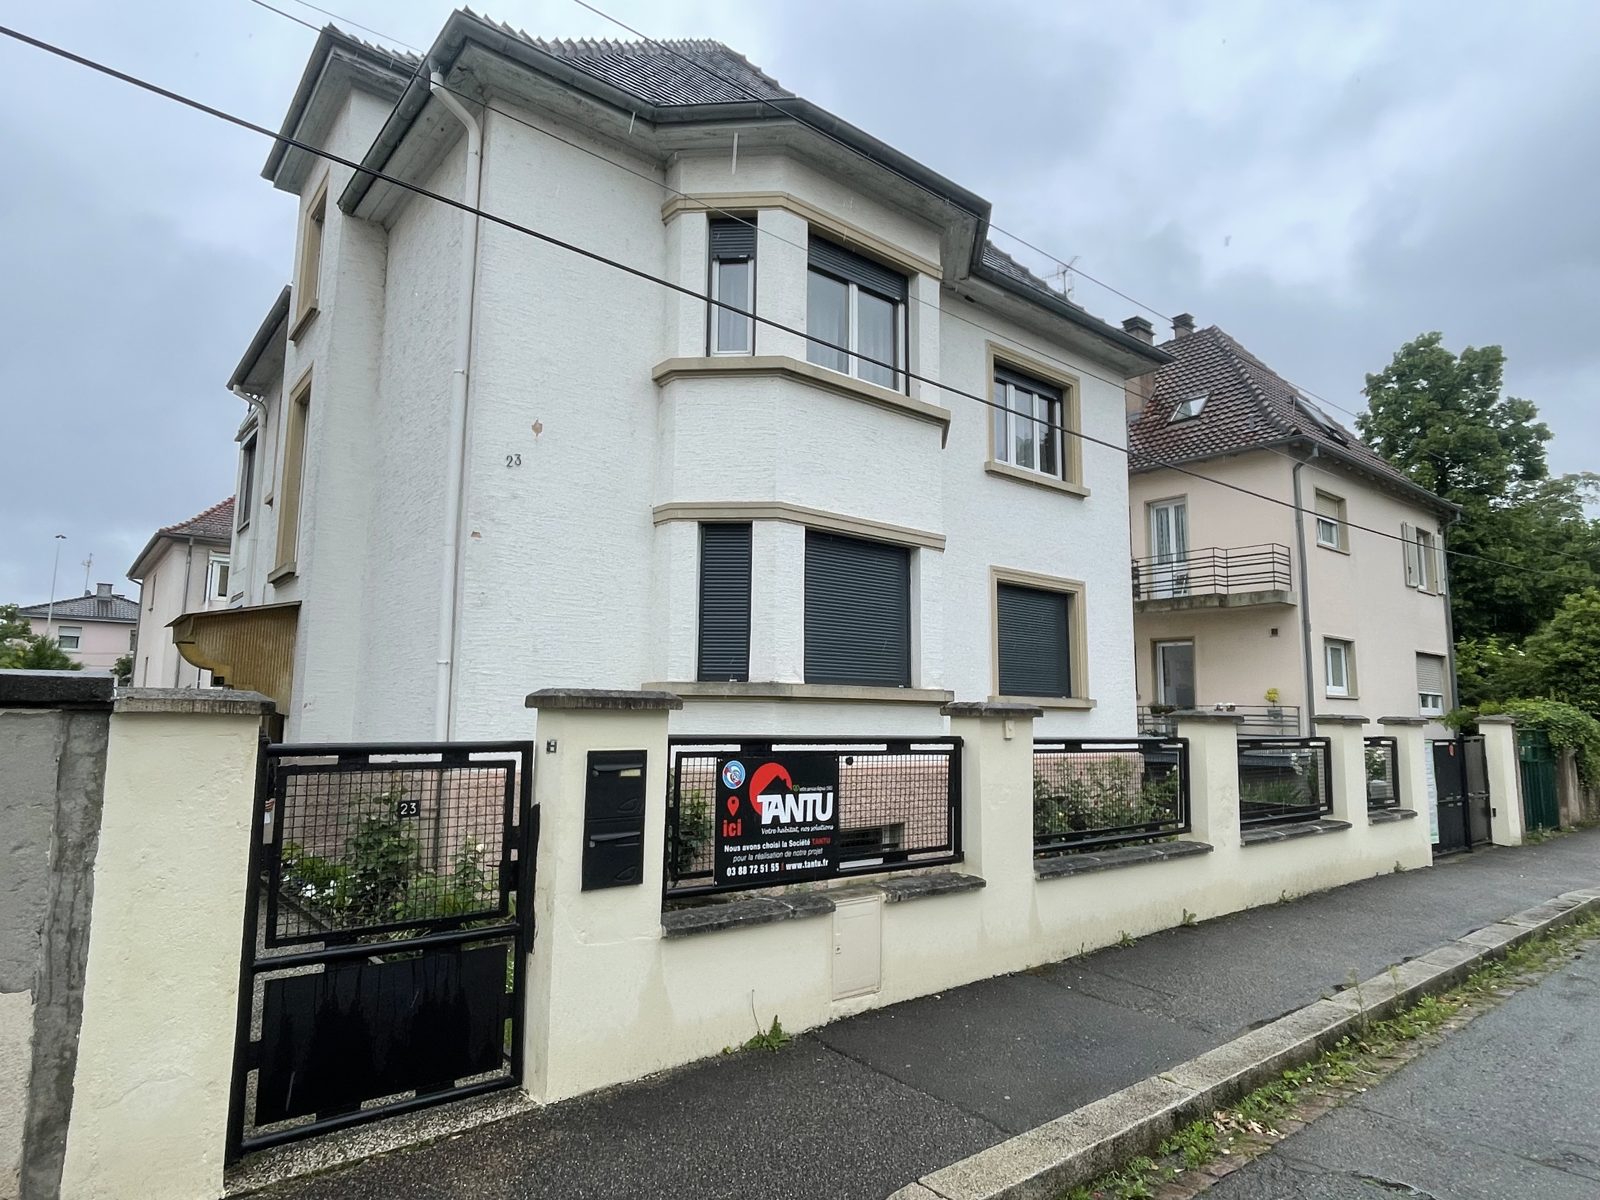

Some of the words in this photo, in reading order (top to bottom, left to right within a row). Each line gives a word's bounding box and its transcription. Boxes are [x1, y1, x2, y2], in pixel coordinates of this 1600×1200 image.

[506, 453, 522, 468] 23
[400, 802, 417, 815] 23
[757, 792, 833, 824] TANTU
[723, 818, 742, 837] ici
[761, 827, 777, 835] Votre
[724, 844, 741, 852] Nous
[742, 843, 761, 851] avons
[762, 841, 781, 849] choisi
[781, 840, 788, 848] la
[788, 838, 811, 847] Société
[812, 837, 831, 845] TANTU
[732, 854, 747, 863] pour
[748, 853, 754, 861] la
[754, 851, 784, 860] réalisation
[784, 850, 792, 858] de
[792, 849, 807, 857] notre
[807, 847, 823, 857] projet
[726, 867, 737, 877] 03
[738, 866, 748, 875] 88
[749, 864, 758, 874] 72
[759, 863, 769, 873] 51
[770, 862, 780, 872] 55
[785, 858, 828, 870] www.tantu.fr
